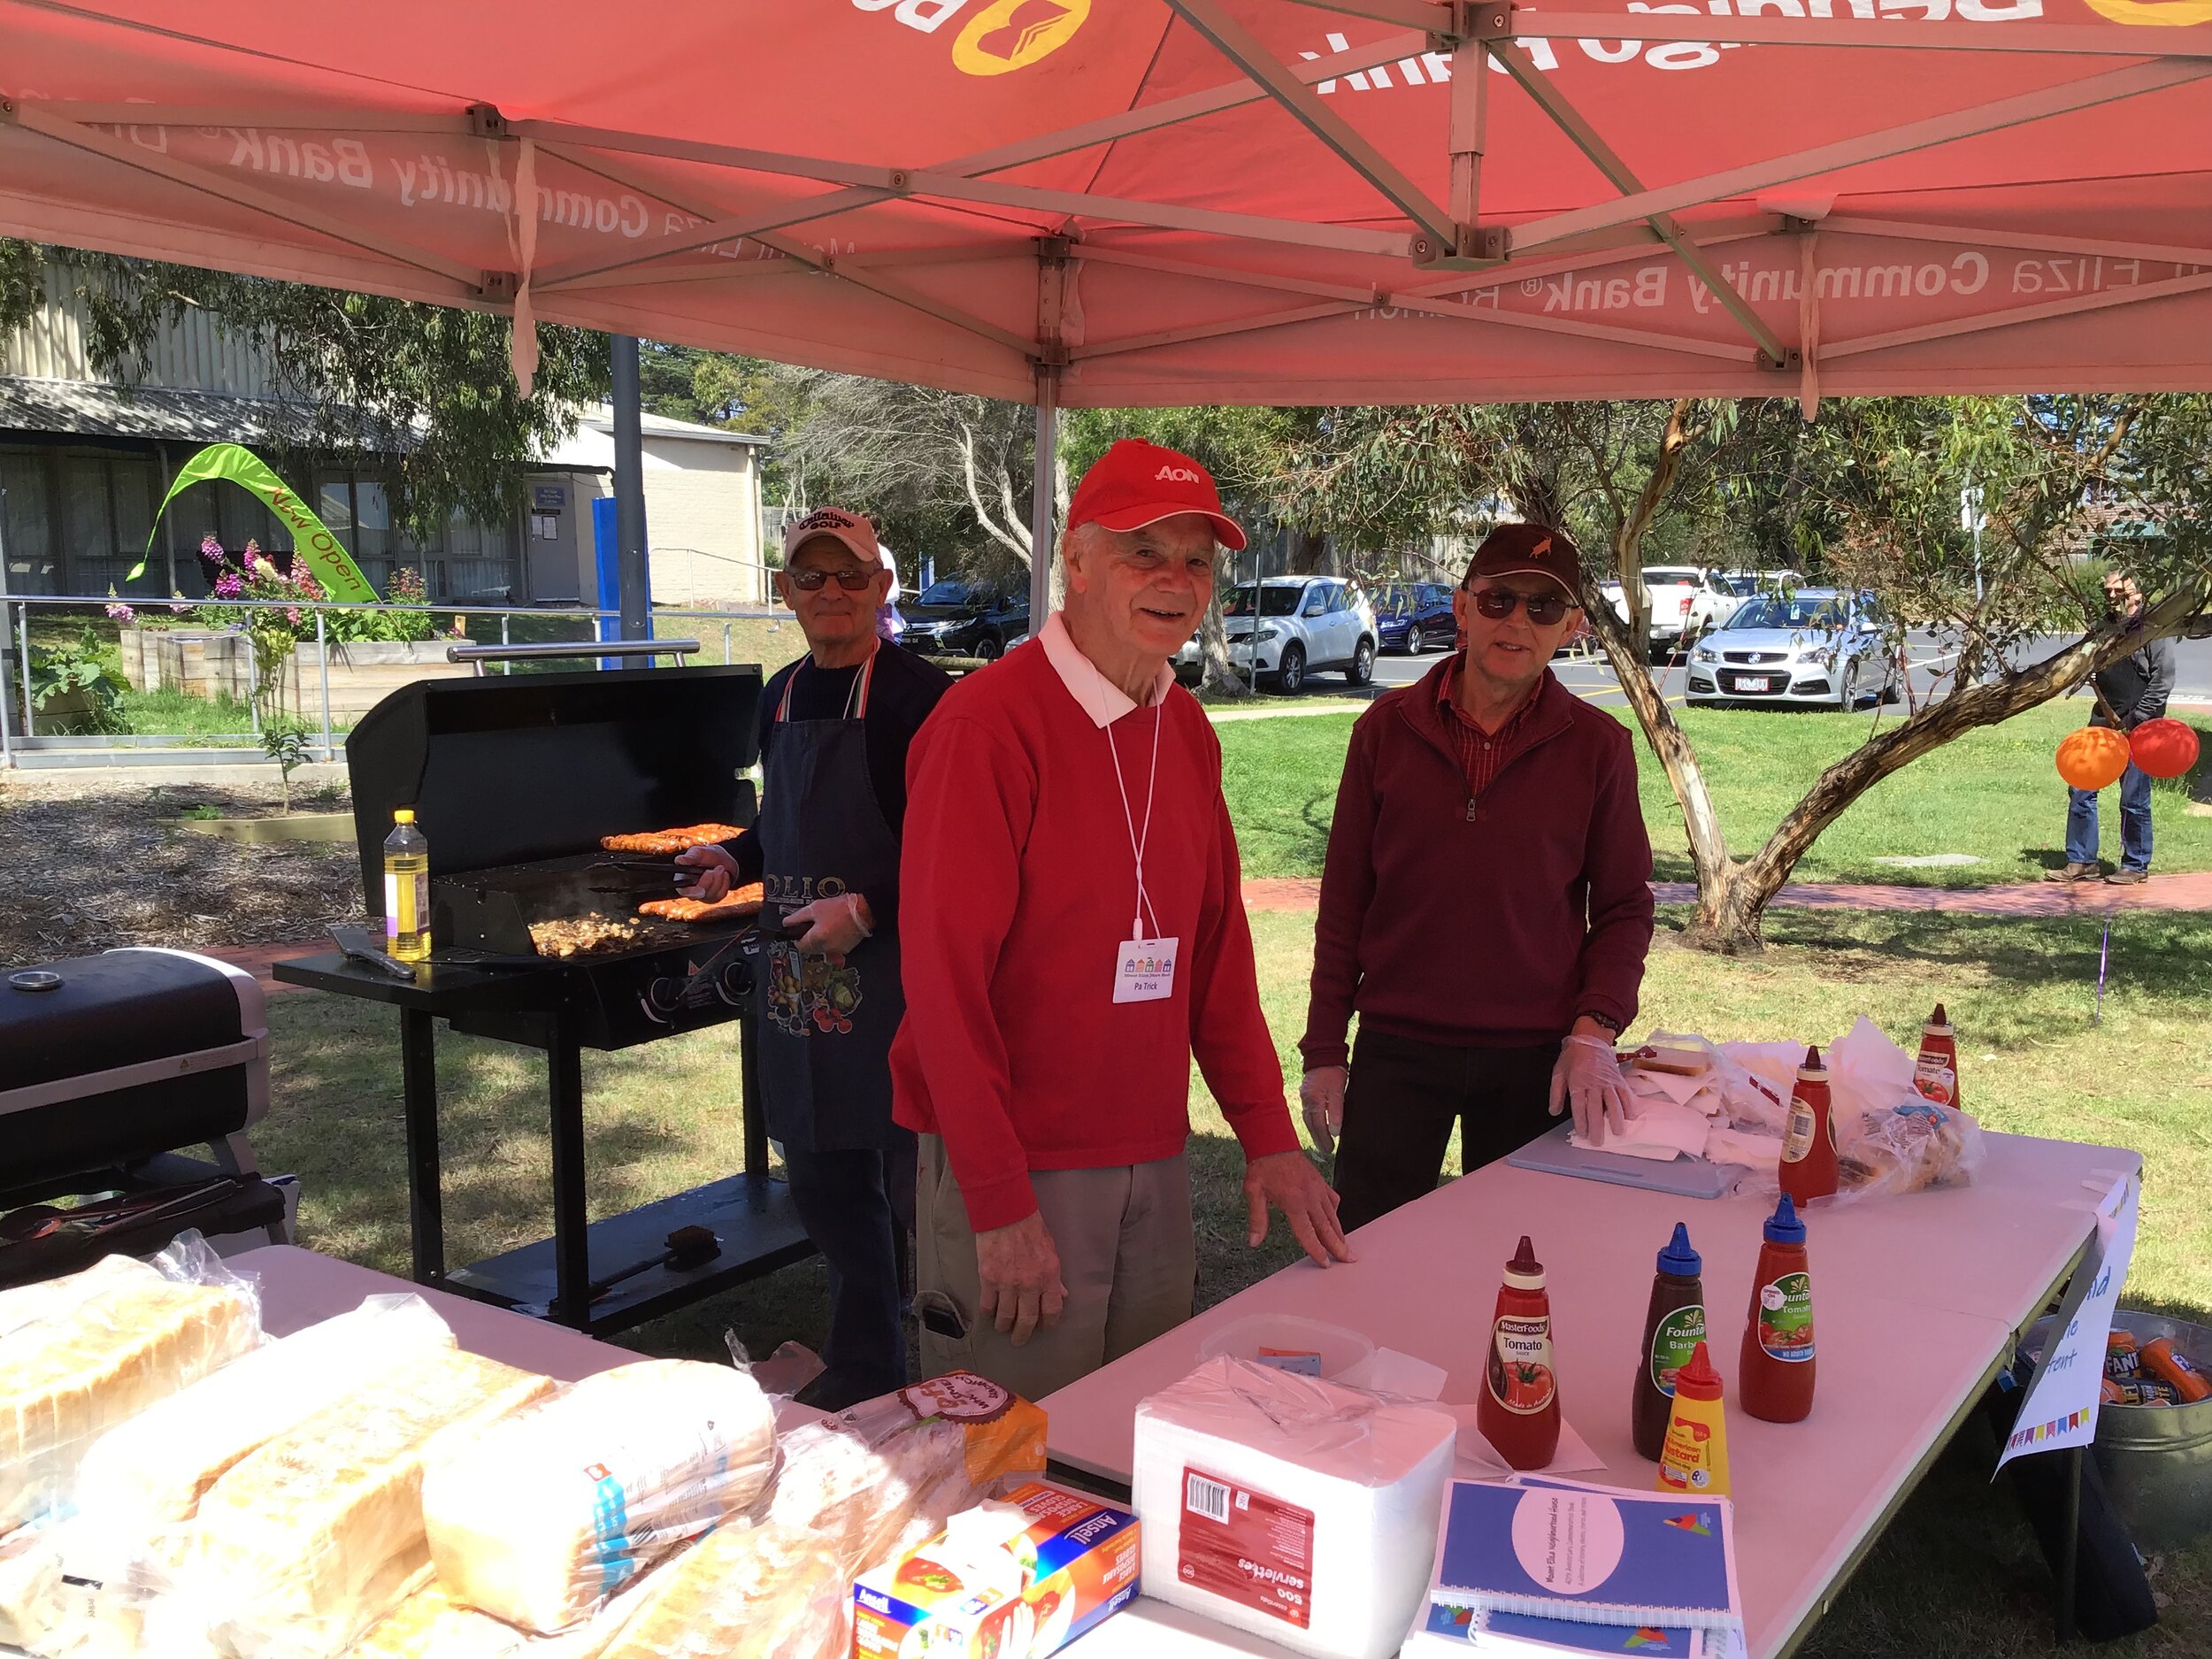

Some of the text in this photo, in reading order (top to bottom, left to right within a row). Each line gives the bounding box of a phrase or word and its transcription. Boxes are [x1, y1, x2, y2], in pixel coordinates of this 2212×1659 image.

[810, 520, 841, 530] GOLF
[311, 533, 361, 591] Open
[1134, 981, 1157, 991] Pa Trick
[1501, 1321, 1546, 1333] MasterFoods
[1503, 1336, 1542, 1351] Tomato
[1069, 1514, 1118, 1546] Ansell
[1237, 1558, 1304, 1589] serviettes
[1108, 1587, 1132, 1612] Ansell
[1277, 1587, 1302, 1606] 500
